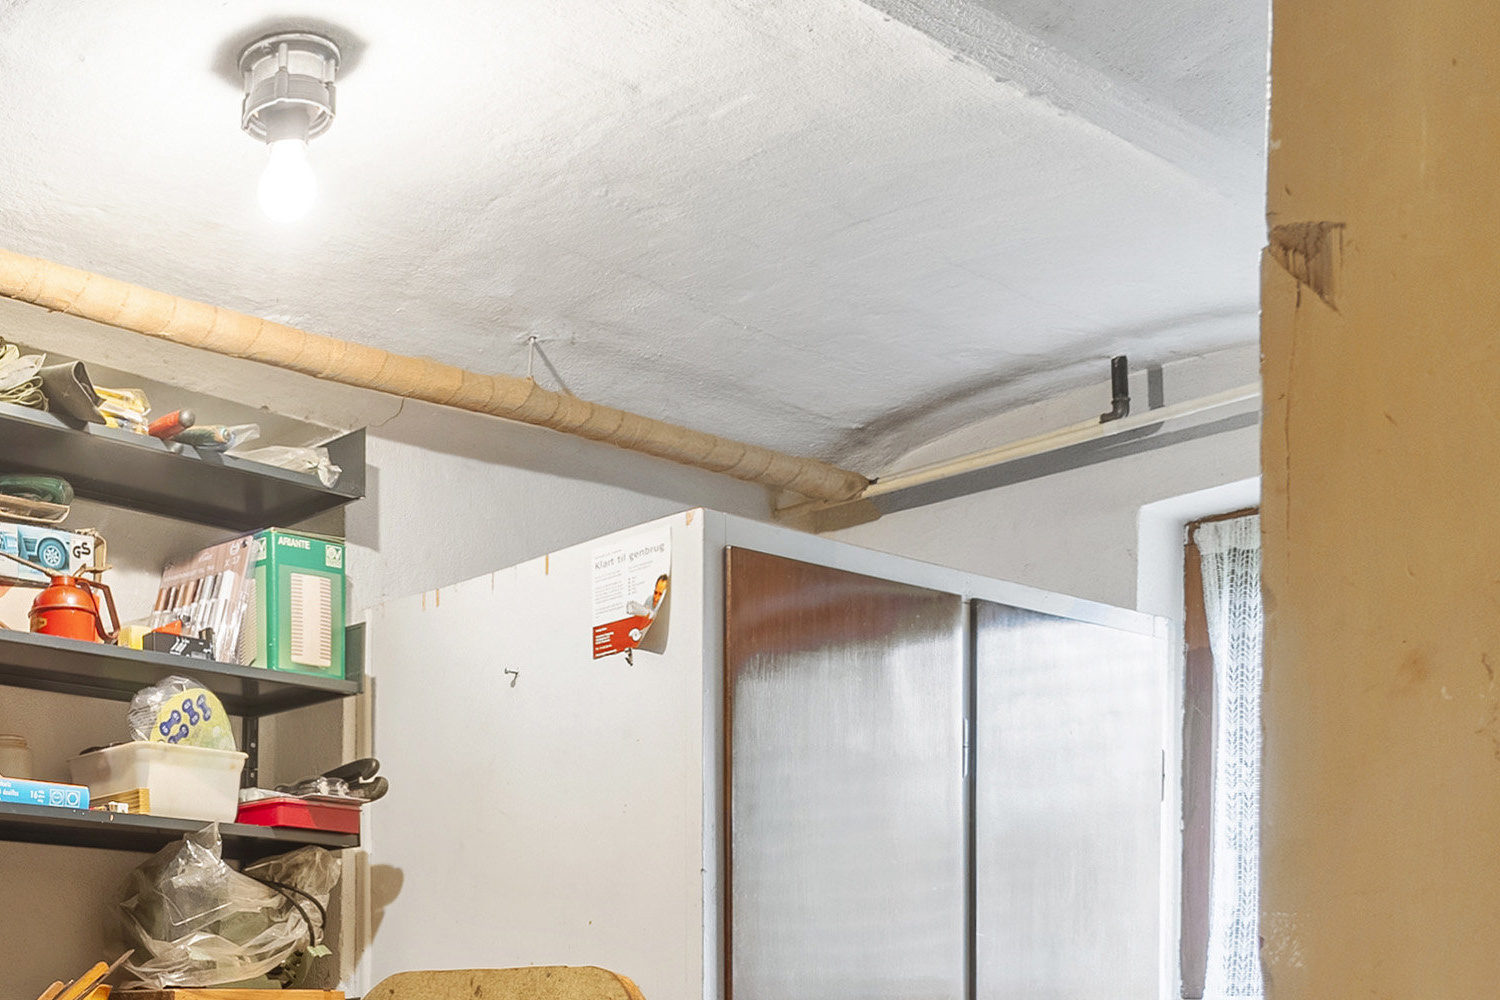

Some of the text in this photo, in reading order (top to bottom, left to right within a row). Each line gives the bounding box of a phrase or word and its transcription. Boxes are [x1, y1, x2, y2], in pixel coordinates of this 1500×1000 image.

[73, 541, 91, 559] GS
[278, 536, 311, 550] ARIANTE
[628, 543, 665, 561] genbrug
